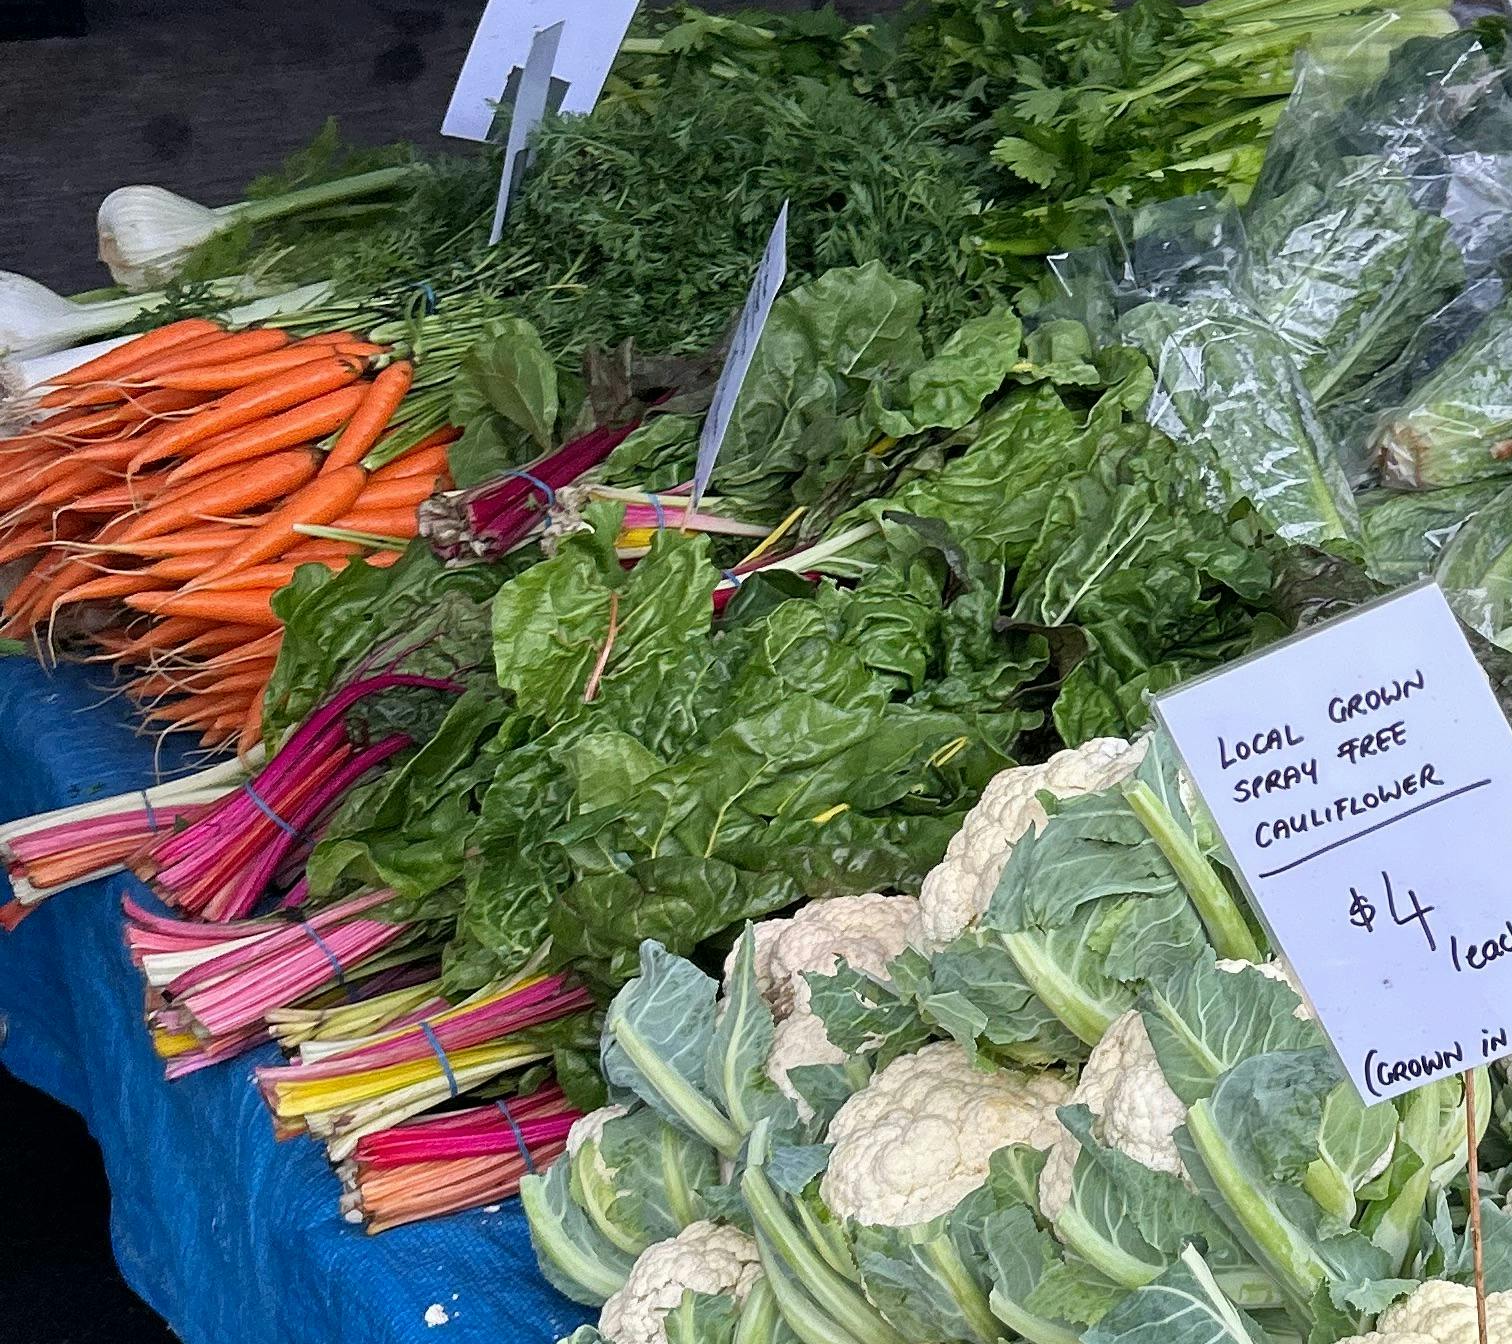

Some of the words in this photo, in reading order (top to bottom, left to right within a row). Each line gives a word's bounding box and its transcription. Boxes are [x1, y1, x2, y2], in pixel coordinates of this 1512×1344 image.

[1218, 725, 1304, 769] LOCAL
[1329, 670, 1424, 722] GROWN
[1233, 759, 1318, 802] SPRAY
[1337, 721, 1406, 764] FREE
[1256, 764, 1444, 848] CAULIFLOWER
[1350, 871, 1436, 951] $4
[1365, 1043, 1463, 1096] (GROWN
